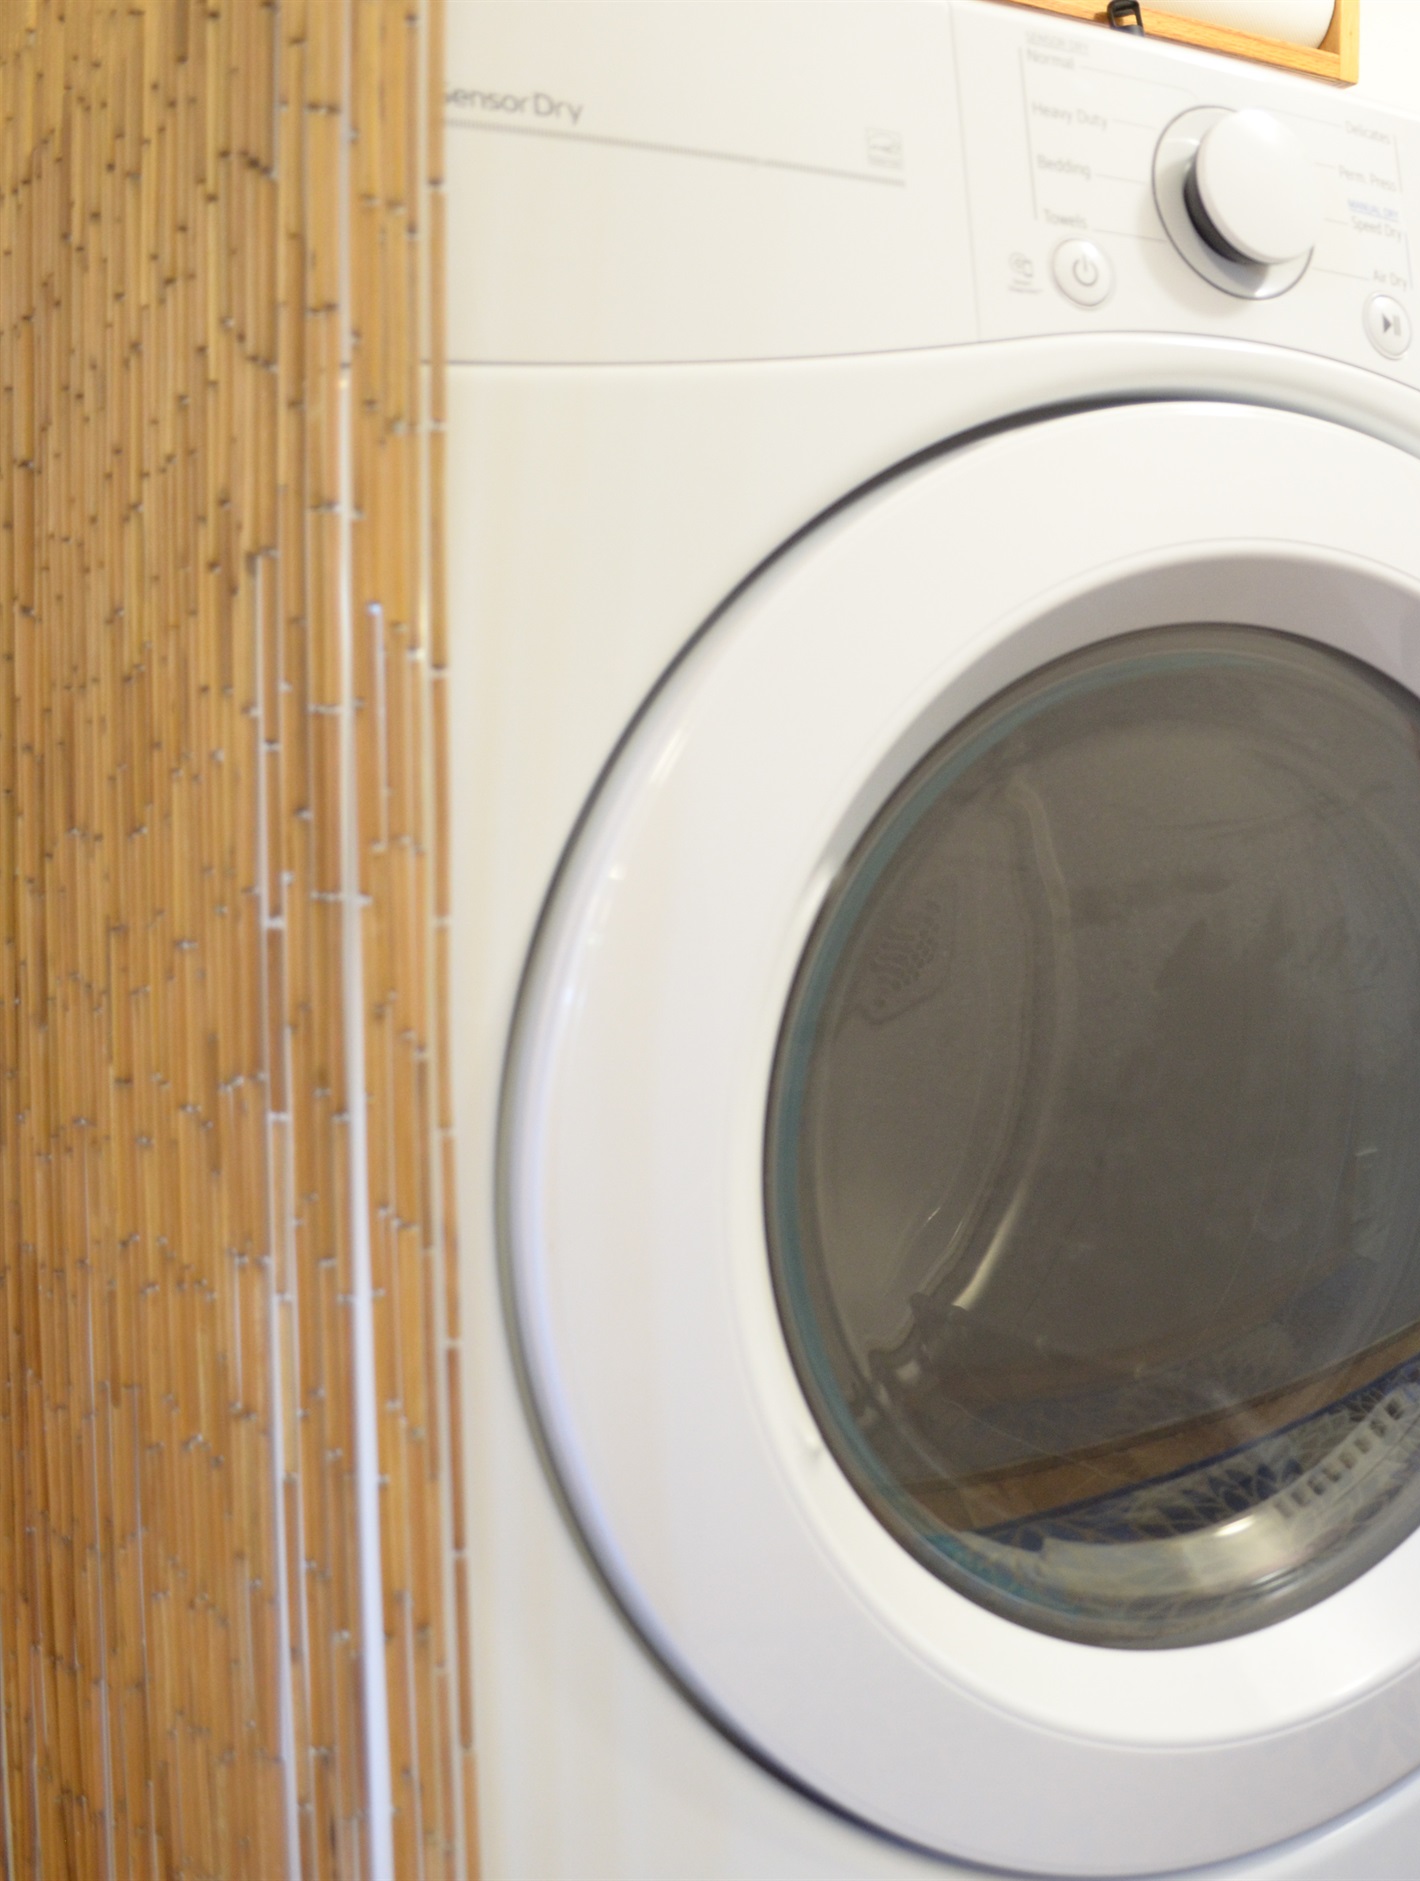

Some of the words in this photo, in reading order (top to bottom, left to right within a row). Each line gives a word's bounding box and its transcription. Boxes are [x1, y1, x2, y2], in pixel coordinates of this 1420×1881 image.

[1027, 48, 1075, 69] Normal
[1031, 101, 1072, 125] Heavy
[1076, 108, 1108, 130] Duty
[1344, 120, 1391, 145] Delicates
[1036, 154, 1092, 181] Bedding
[1370, 172, 1397, 192] Press
[1043, 208, 1088, 230] Towels
[1351, 215, 1383, 235] Speed
[1384, 223, 1402, 243] Dry
[1390, 271, 1407, 292] Dry
